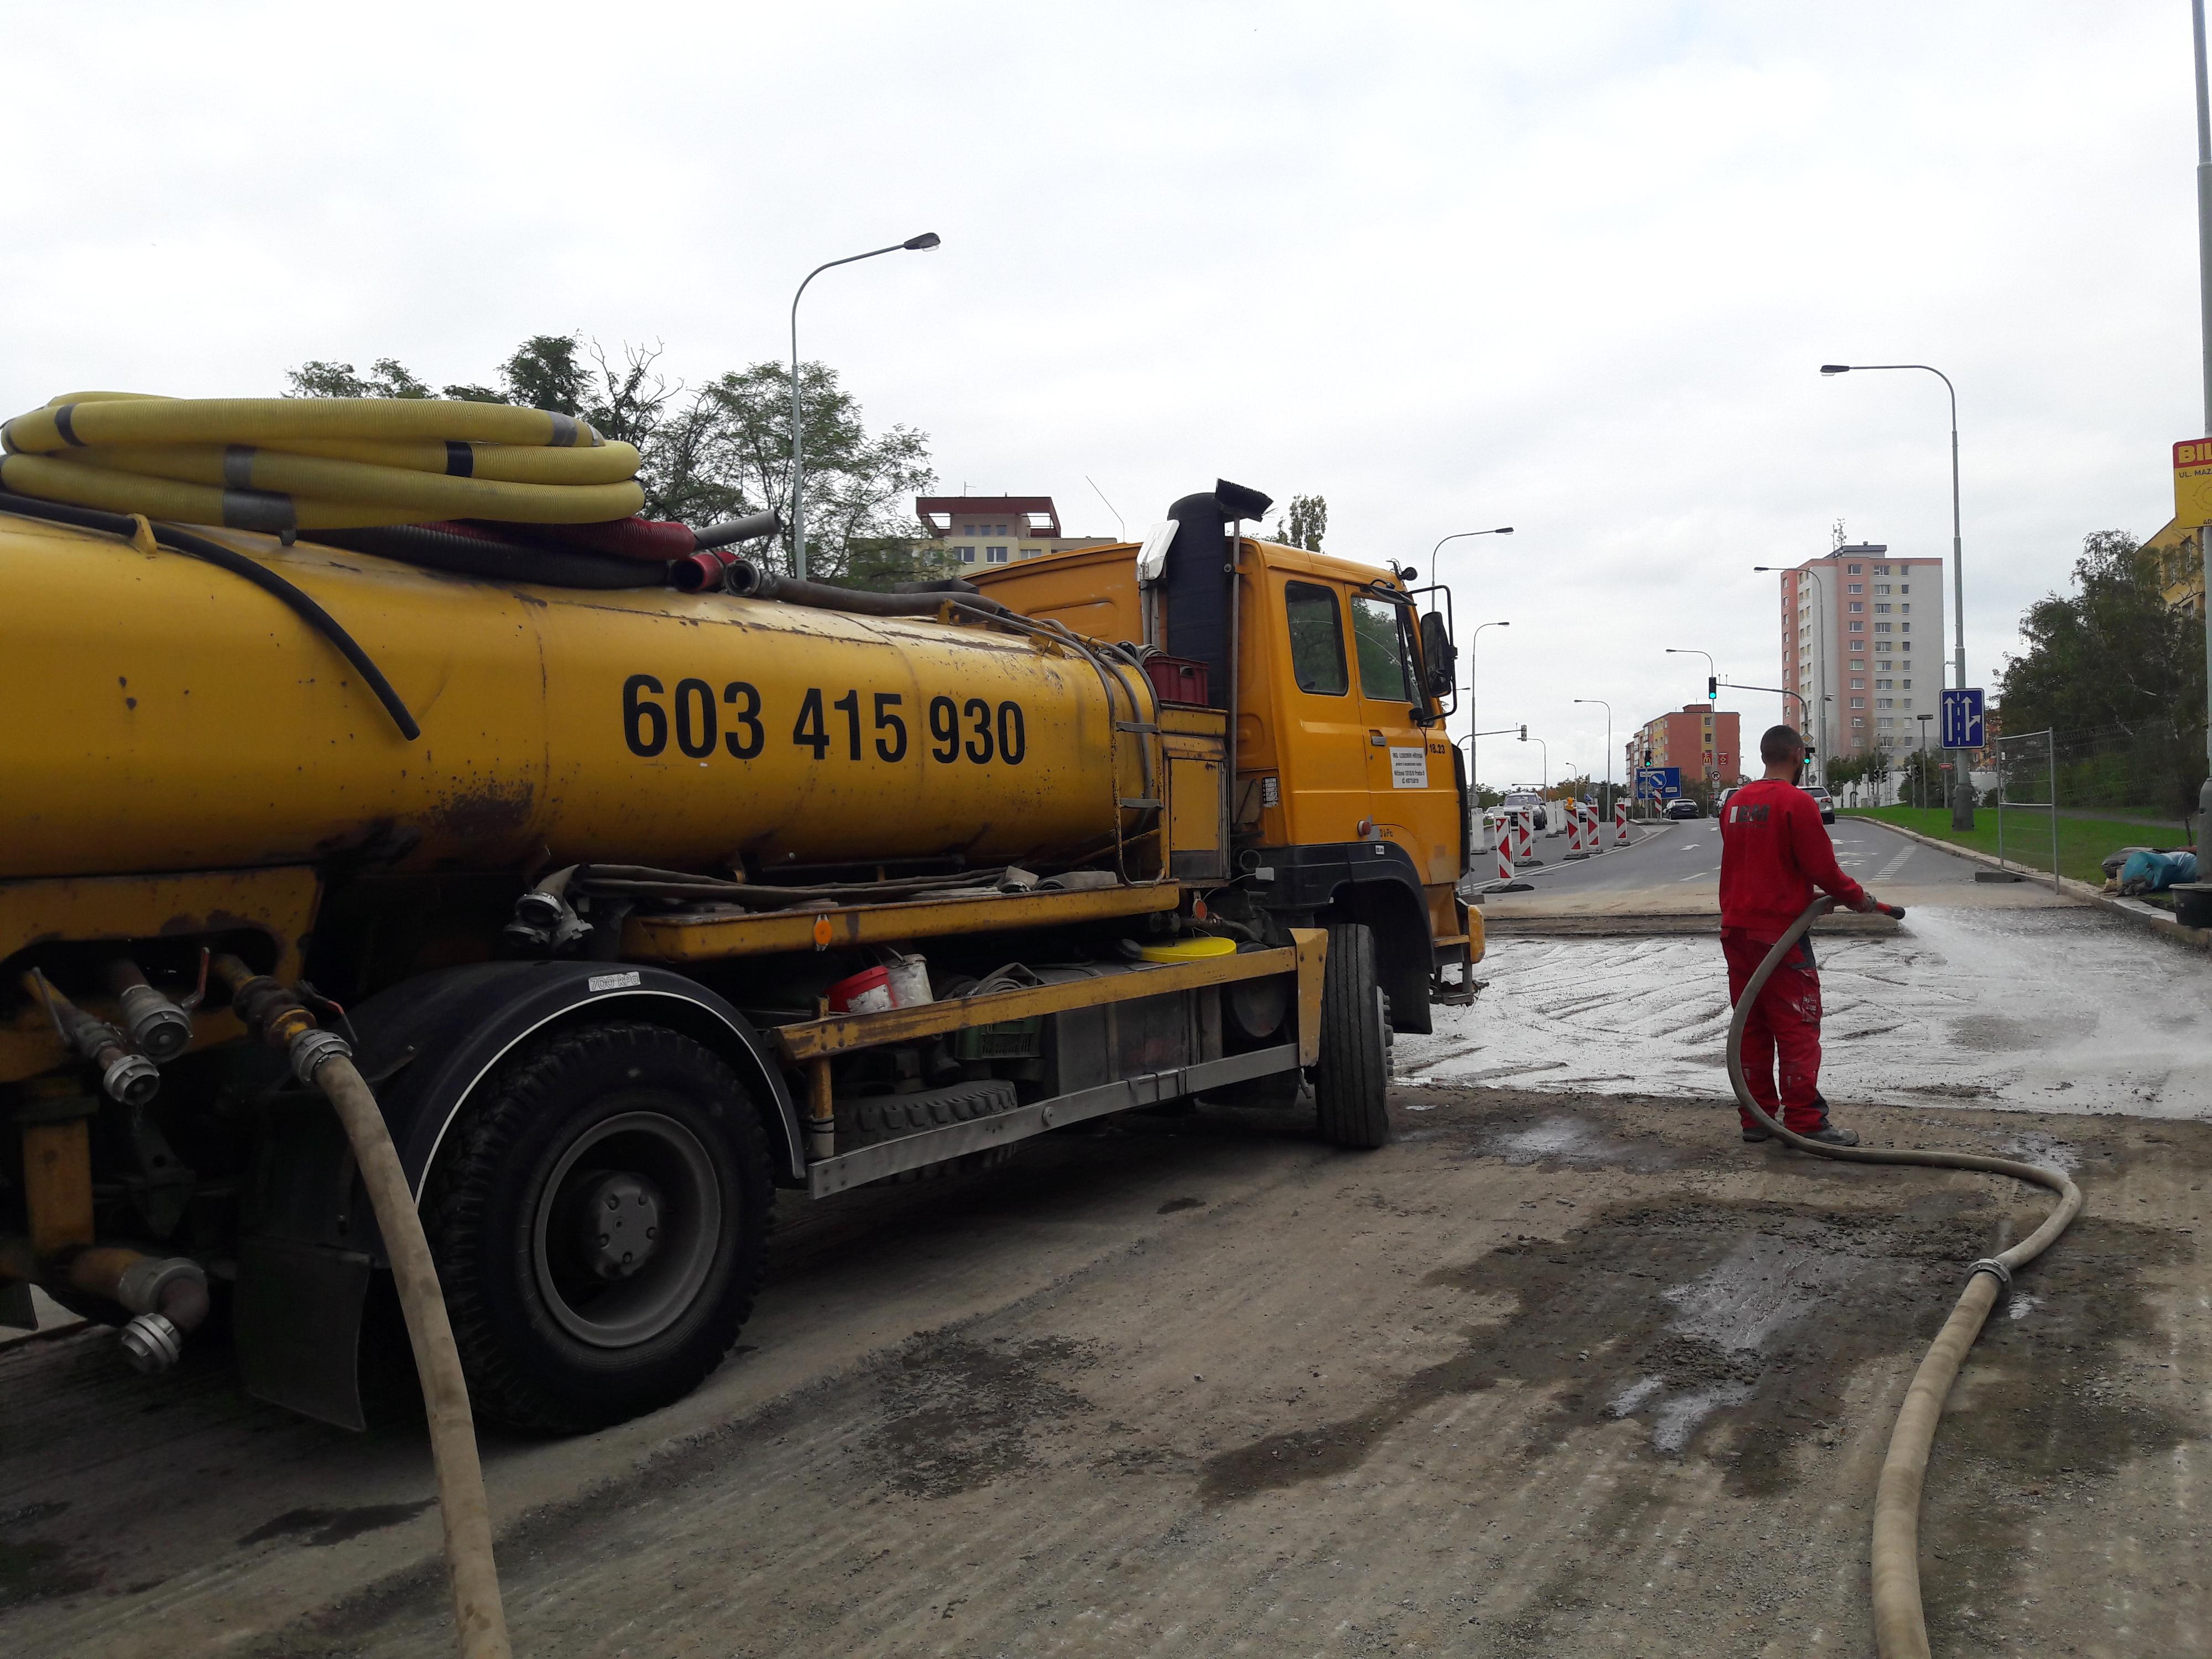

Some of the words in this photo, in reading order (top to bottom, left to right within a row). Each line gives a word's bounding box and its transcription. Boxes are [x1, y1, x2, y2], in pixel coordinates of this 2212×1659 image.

[622, 674, 765, 760] 603
[792, 687, 907, 763] 415
[928, 696, 1025, 765] 930
[1429, 743, 1446, 754] 18.23
[590, 976, 614, 990] 700
[617, 974, 639, 987] kPa
